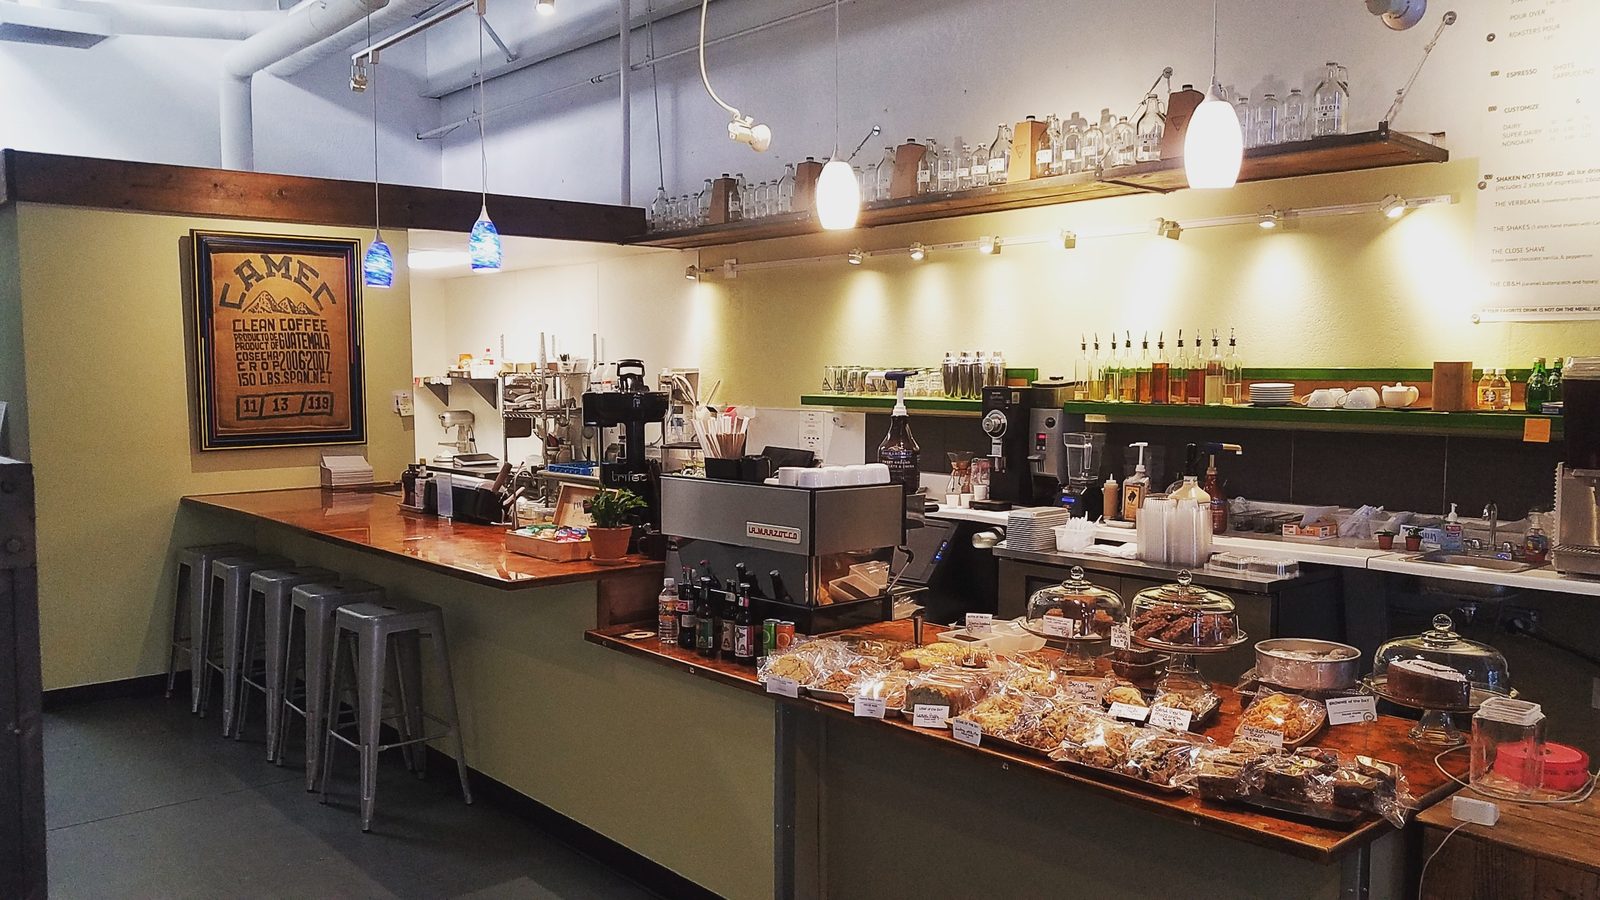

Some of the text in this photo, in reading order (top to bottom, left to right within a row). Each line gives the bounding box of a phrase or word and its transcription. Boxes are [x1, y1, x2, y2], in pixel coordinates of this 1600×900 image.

[1506, 68, 1538, 78] ESPRESSO
[1504, 104, 1540, 114] CUSTOMIZE
[232, 319, 328, 332] CLEAN COFFEE
[234, 333, 278, 341] PRODUCTO DE
[278, 333, 330, 350] GUATEMALA
[235, 342, 278, 350] PRODUCT OF
[236, 352, 279, 361] COSECHA
[238, 373, 256, 386] 150
[244, 400, 258, 412] 11
[272, 398, 288, 411] 13
